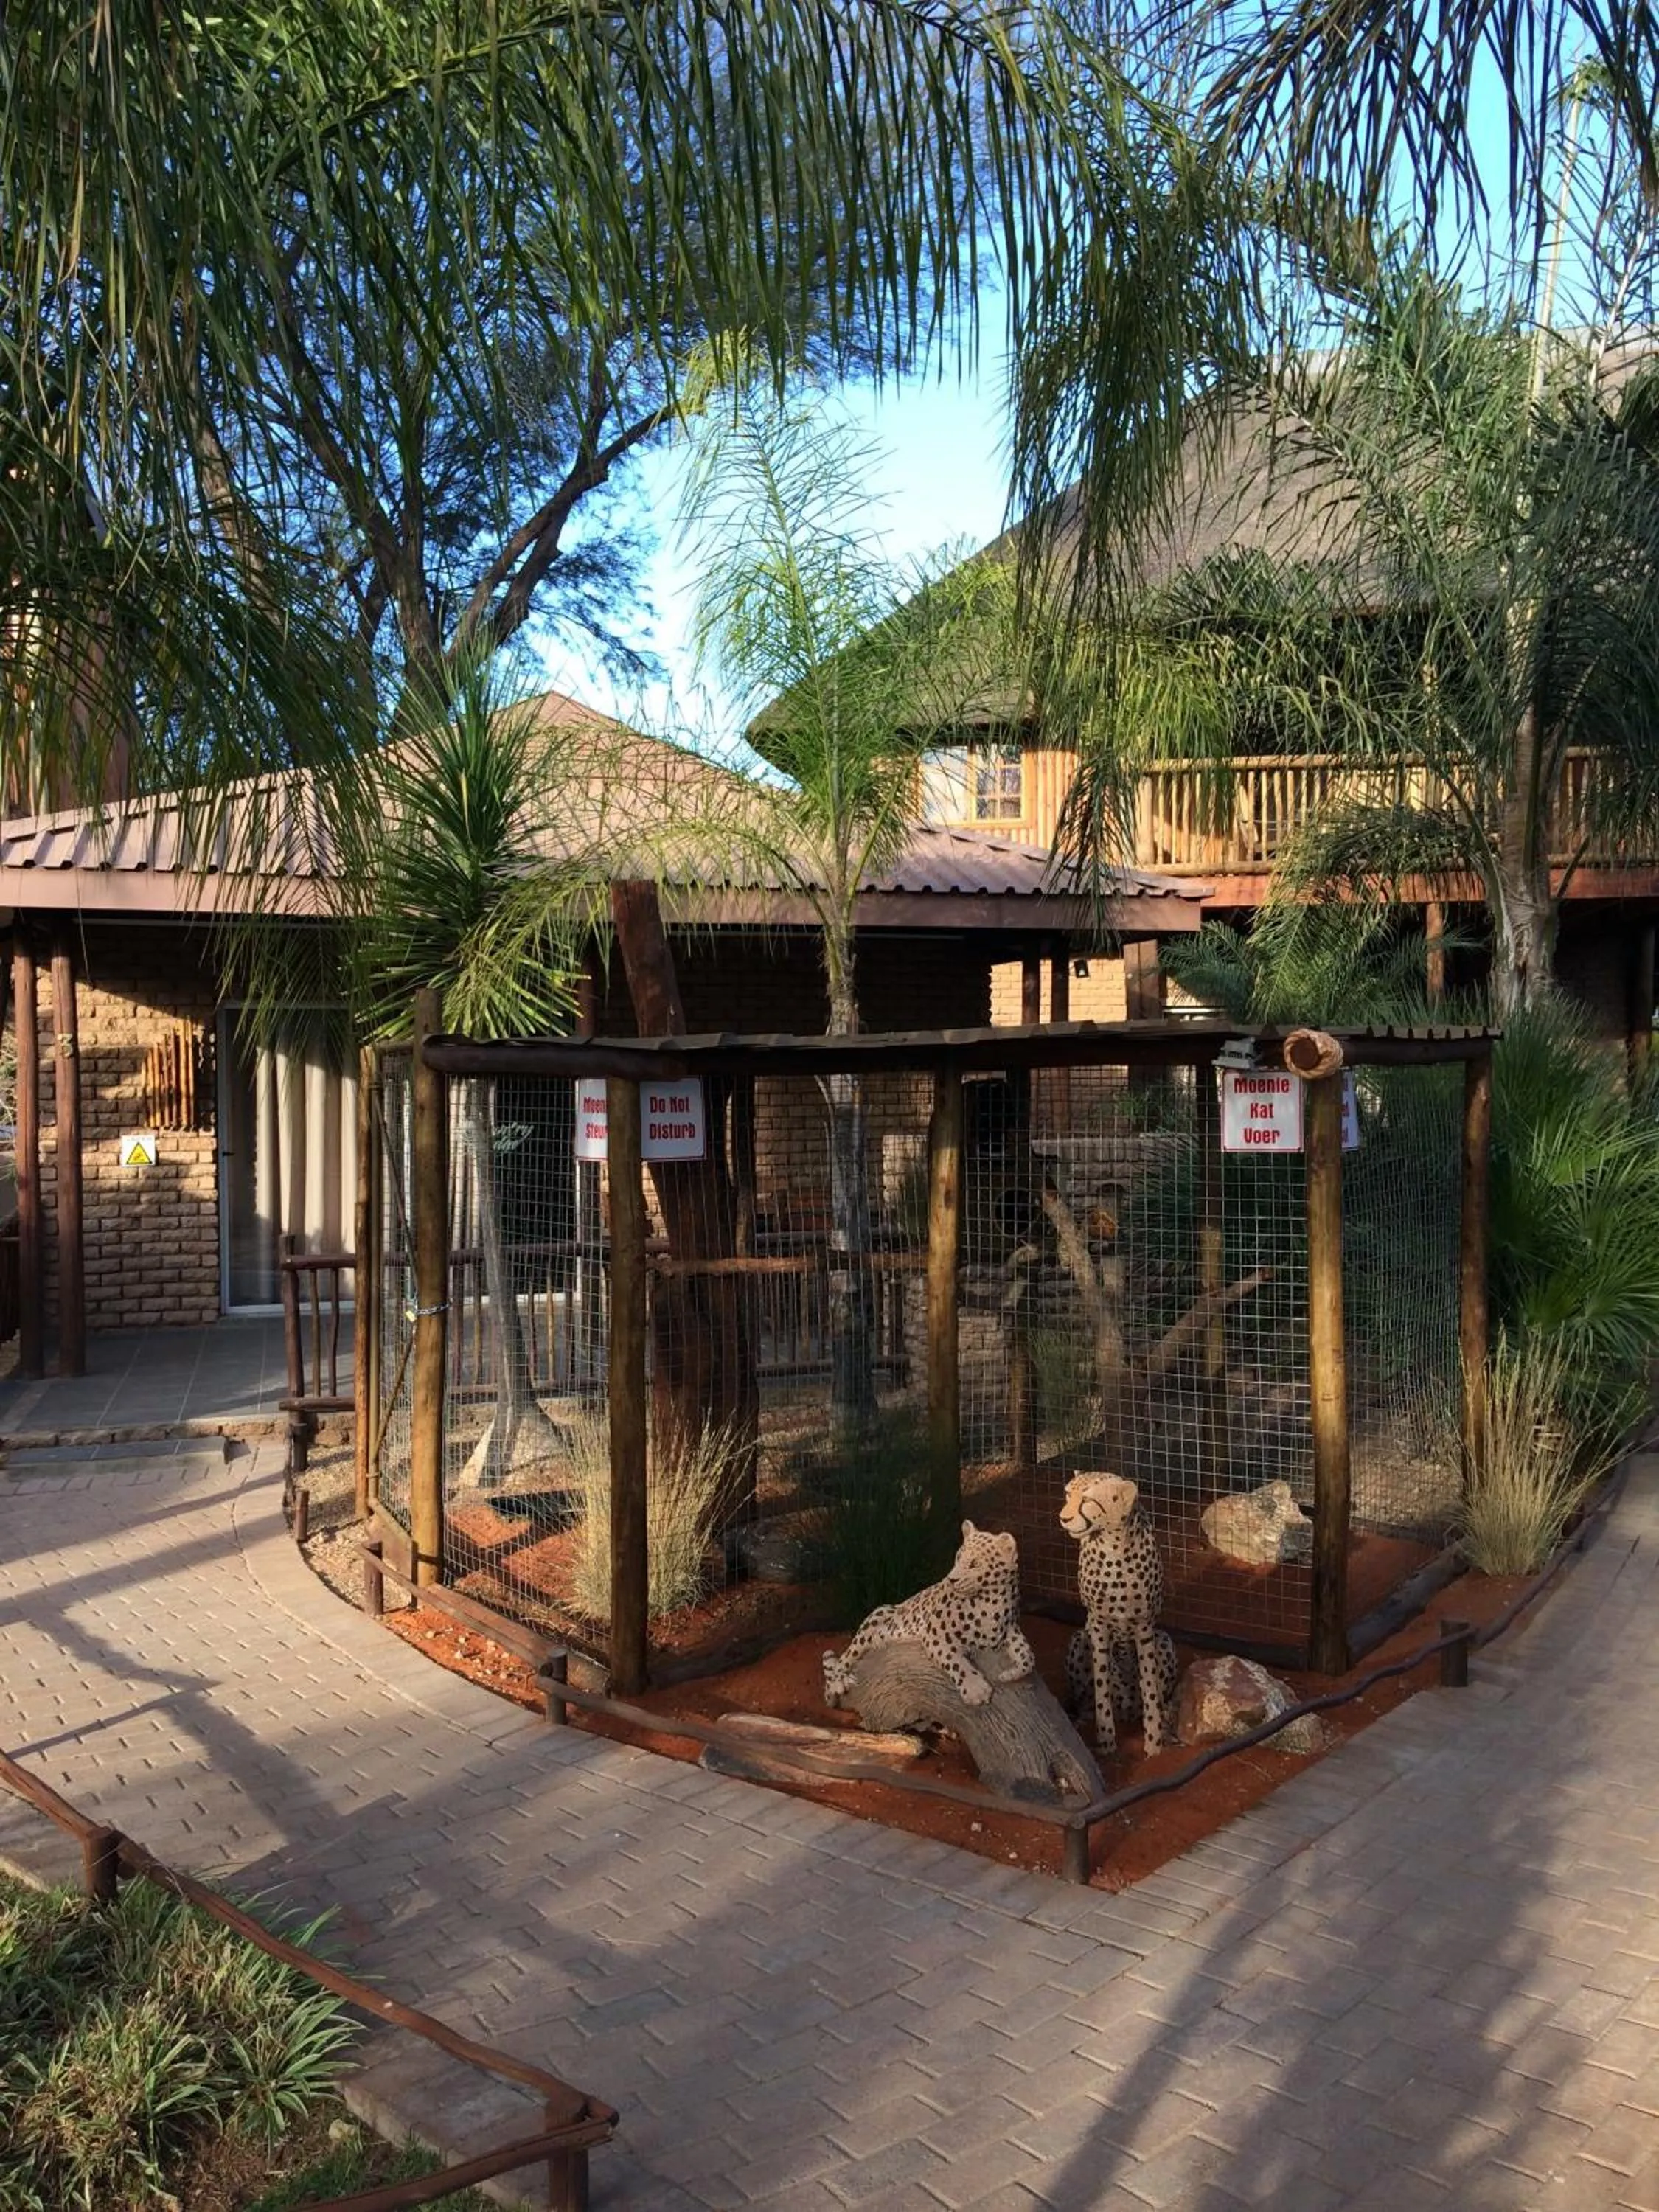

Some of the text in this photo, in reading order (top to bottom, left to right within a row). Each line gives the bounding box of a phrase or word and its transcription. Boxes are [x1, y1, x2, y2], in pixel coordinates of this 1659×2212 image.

[58, 1033, 73, 1057] 3
[1234, 1077, 1290, 1094] Moenie
[582, 1096, 608, 1114] Moen
[650, 1096, 690, 1113] Do Not
[1250, 1103, 1274, 1119] Kat
[649, 1121, 695, 1140] Disturb
[1243, 1128, 1281, 1144] Voer
